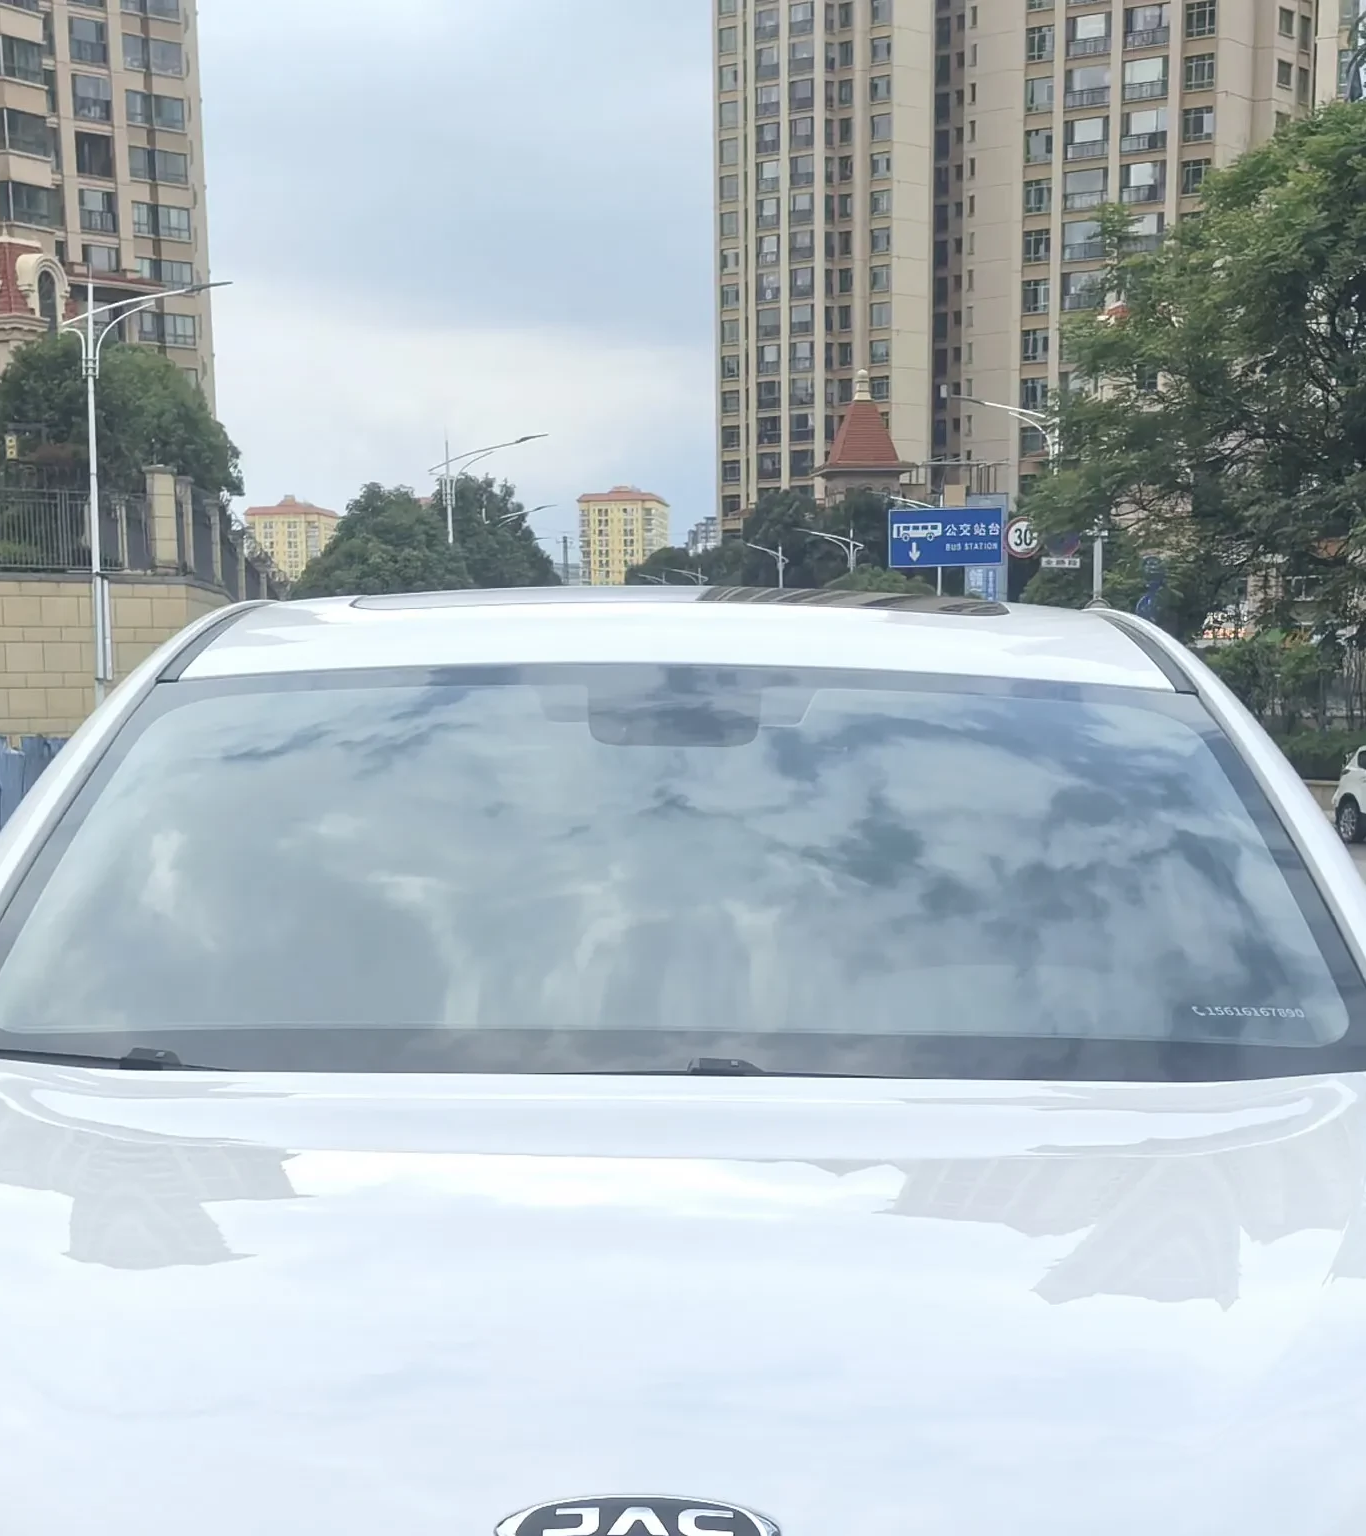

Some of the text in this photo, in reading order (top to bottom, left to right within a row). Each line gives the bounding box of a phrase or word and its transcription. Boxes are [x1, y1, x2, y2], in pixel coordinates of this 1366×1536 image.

[945, 522, 1001, 537] 公交站台
[1014, 528, 1033, 547] 30
[945, 542, 998, 552] BUS STATION
